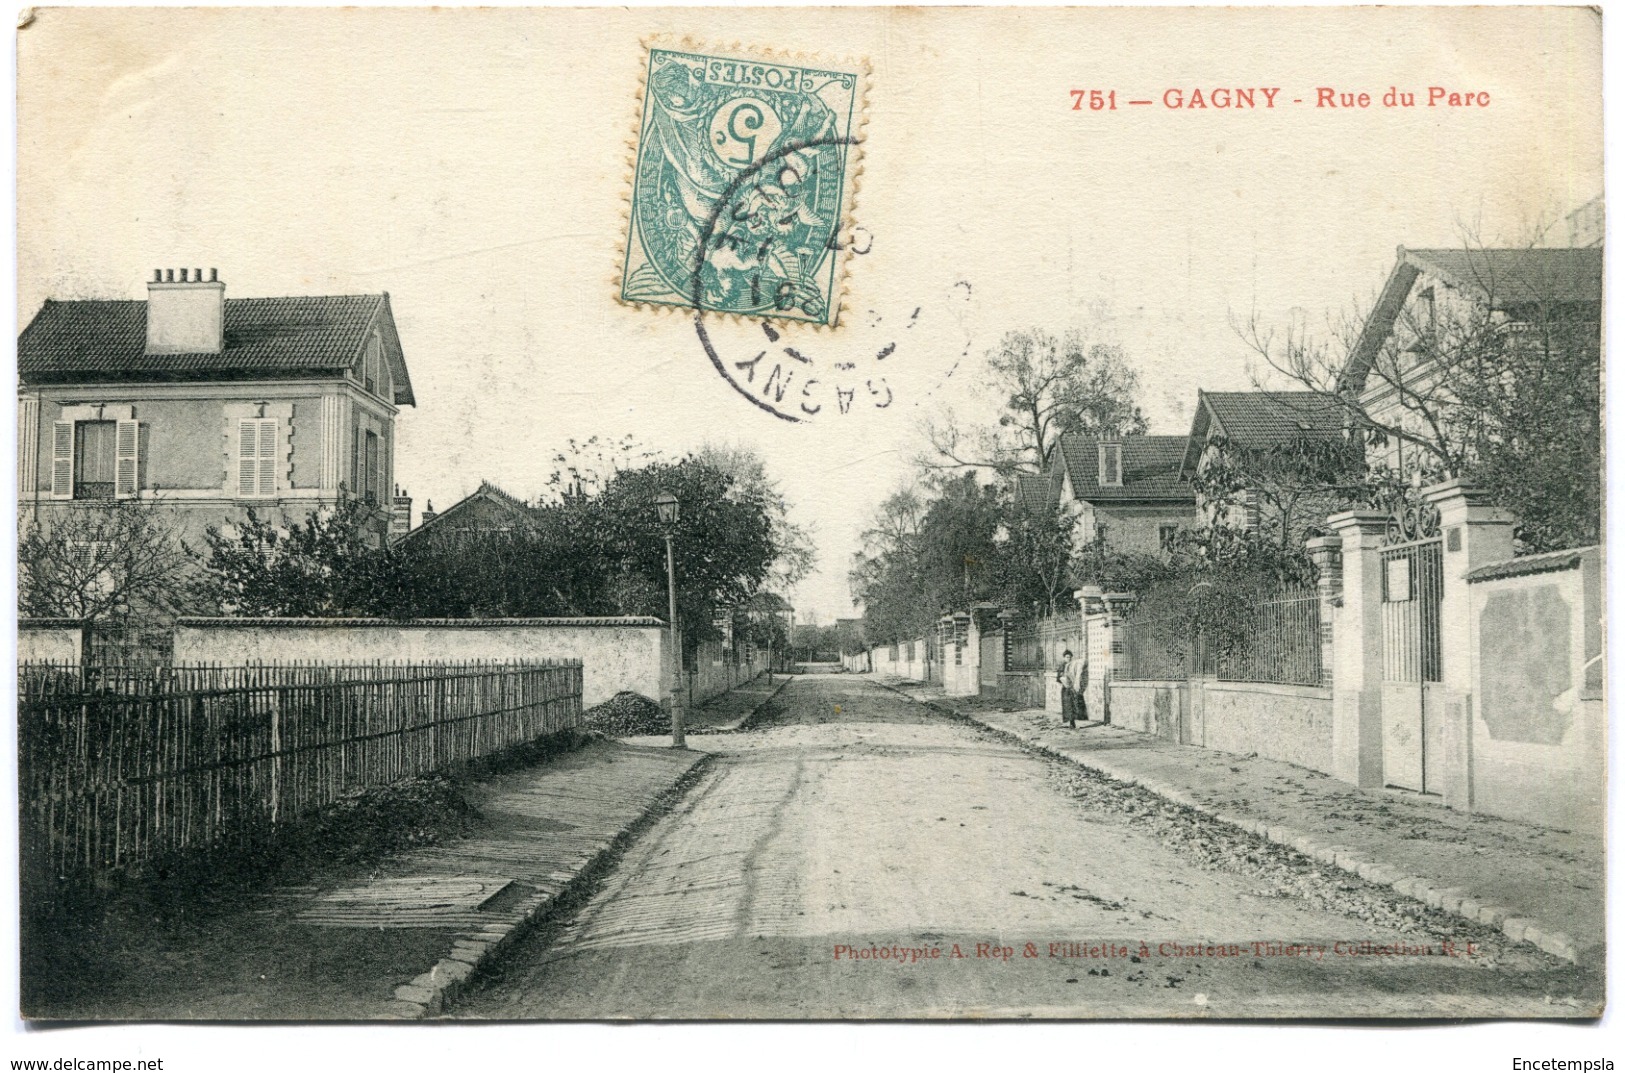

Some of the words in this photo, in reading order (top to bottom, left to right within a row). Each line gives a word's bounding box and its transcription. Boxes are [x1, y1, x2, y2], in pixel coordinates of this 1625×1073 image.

[709, 61, 799, 91] POSTES
[1069, 89, 1117, 111] 751
[1162, 87, 1281, 110] GAGNY
[1316, 86, 1371, 109] Rue
[1382, 86, 1416, 108] du
[1427, 86, 1491, 108] Parc
[833, 943, 942, 964] Phototypie
[950, 943, 969, 960] A.
[1022, 941, 1039, 959] &
